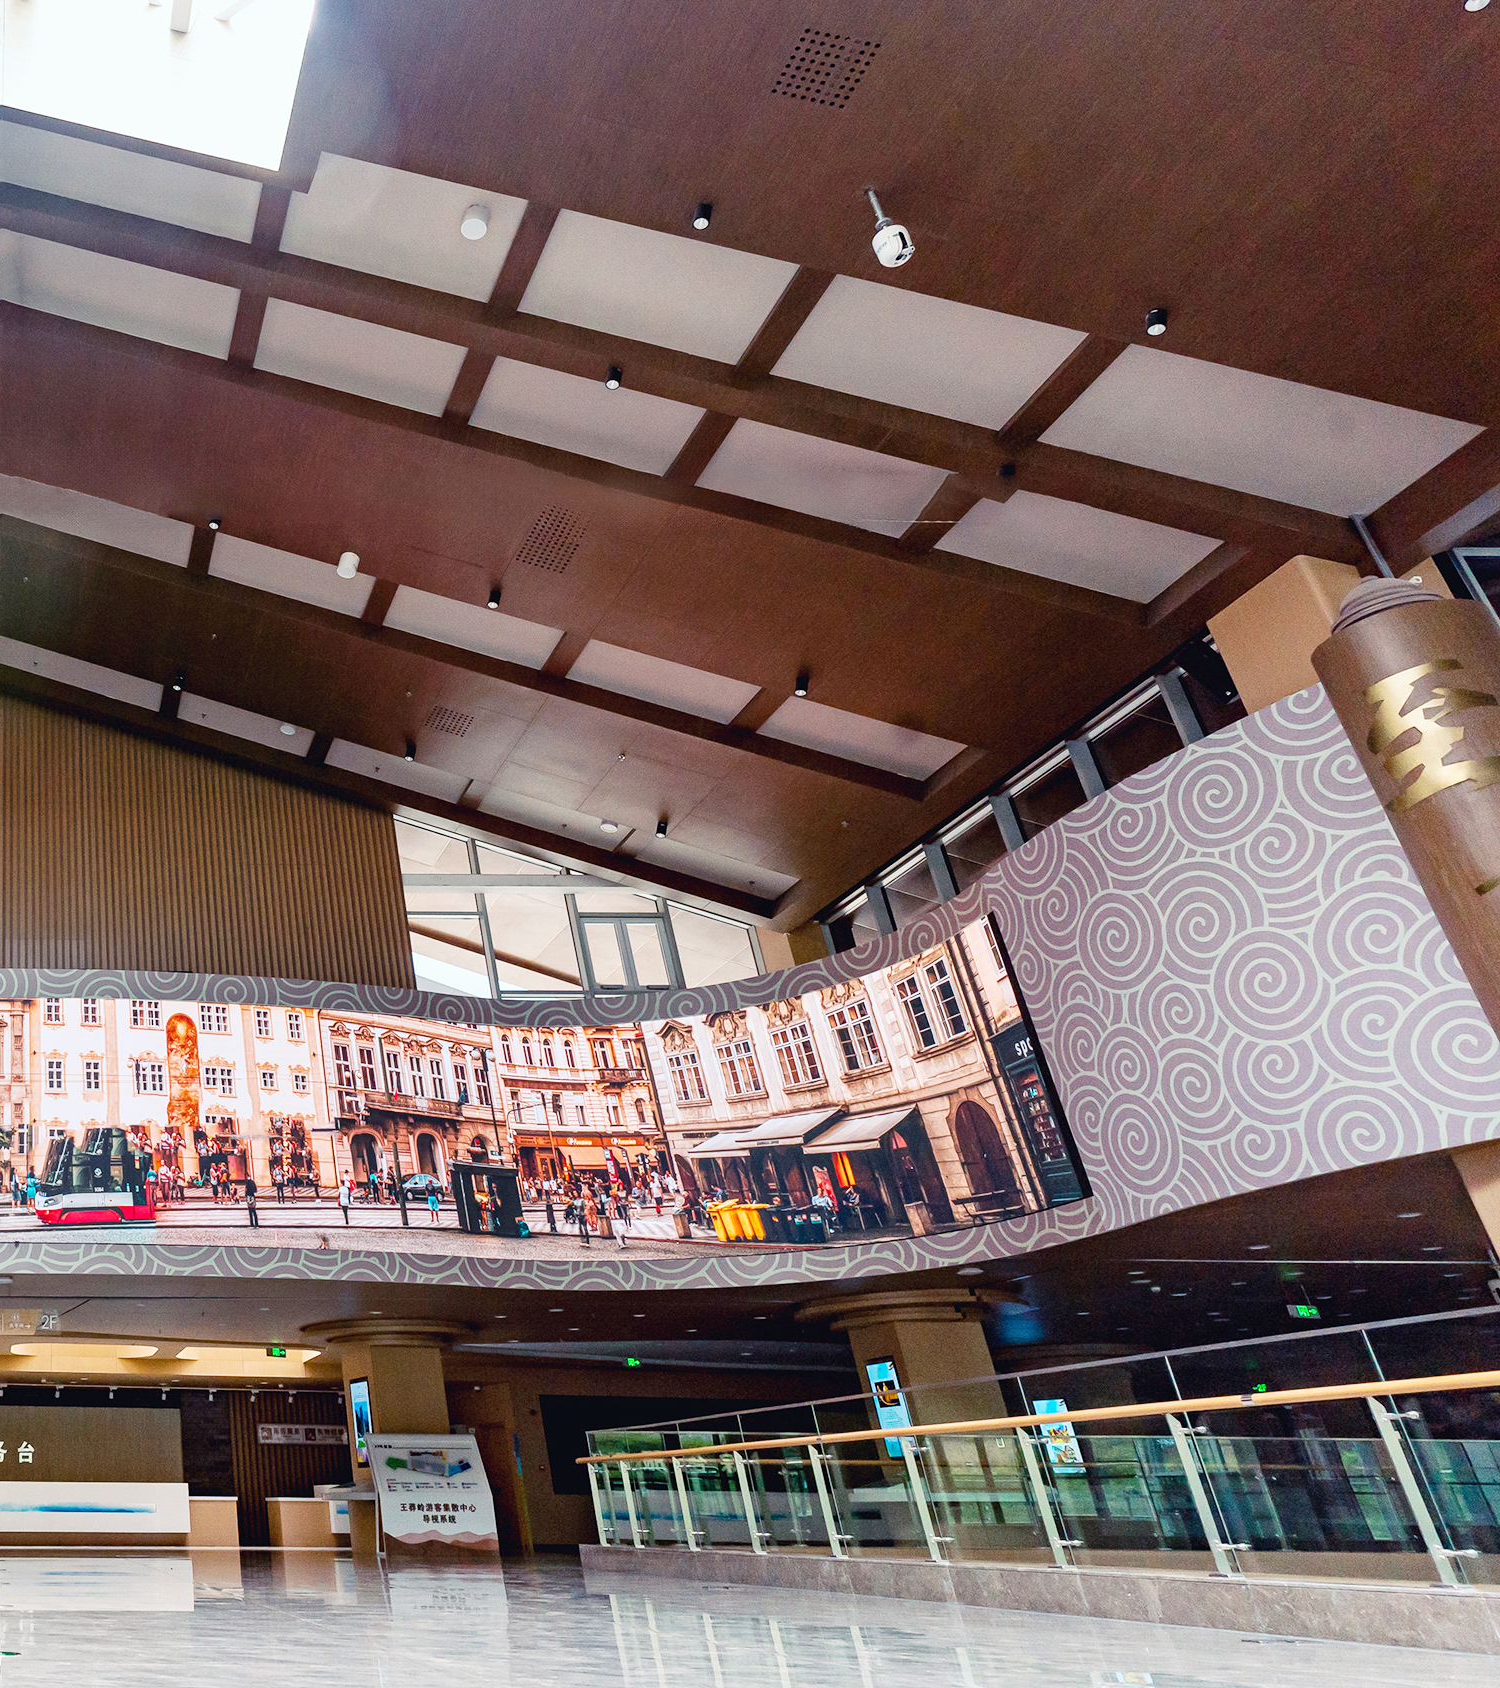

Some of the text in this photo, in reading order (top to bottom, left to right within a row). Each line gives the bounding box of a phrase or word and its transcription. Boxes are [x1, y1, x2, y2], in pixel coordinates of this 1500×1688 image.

[41, 1315, 58, 1330] 2F
[400, 1503, 477, 1513] 王莽岭游客集散中心
[423, 1514, 457, 1524] 导视系统
